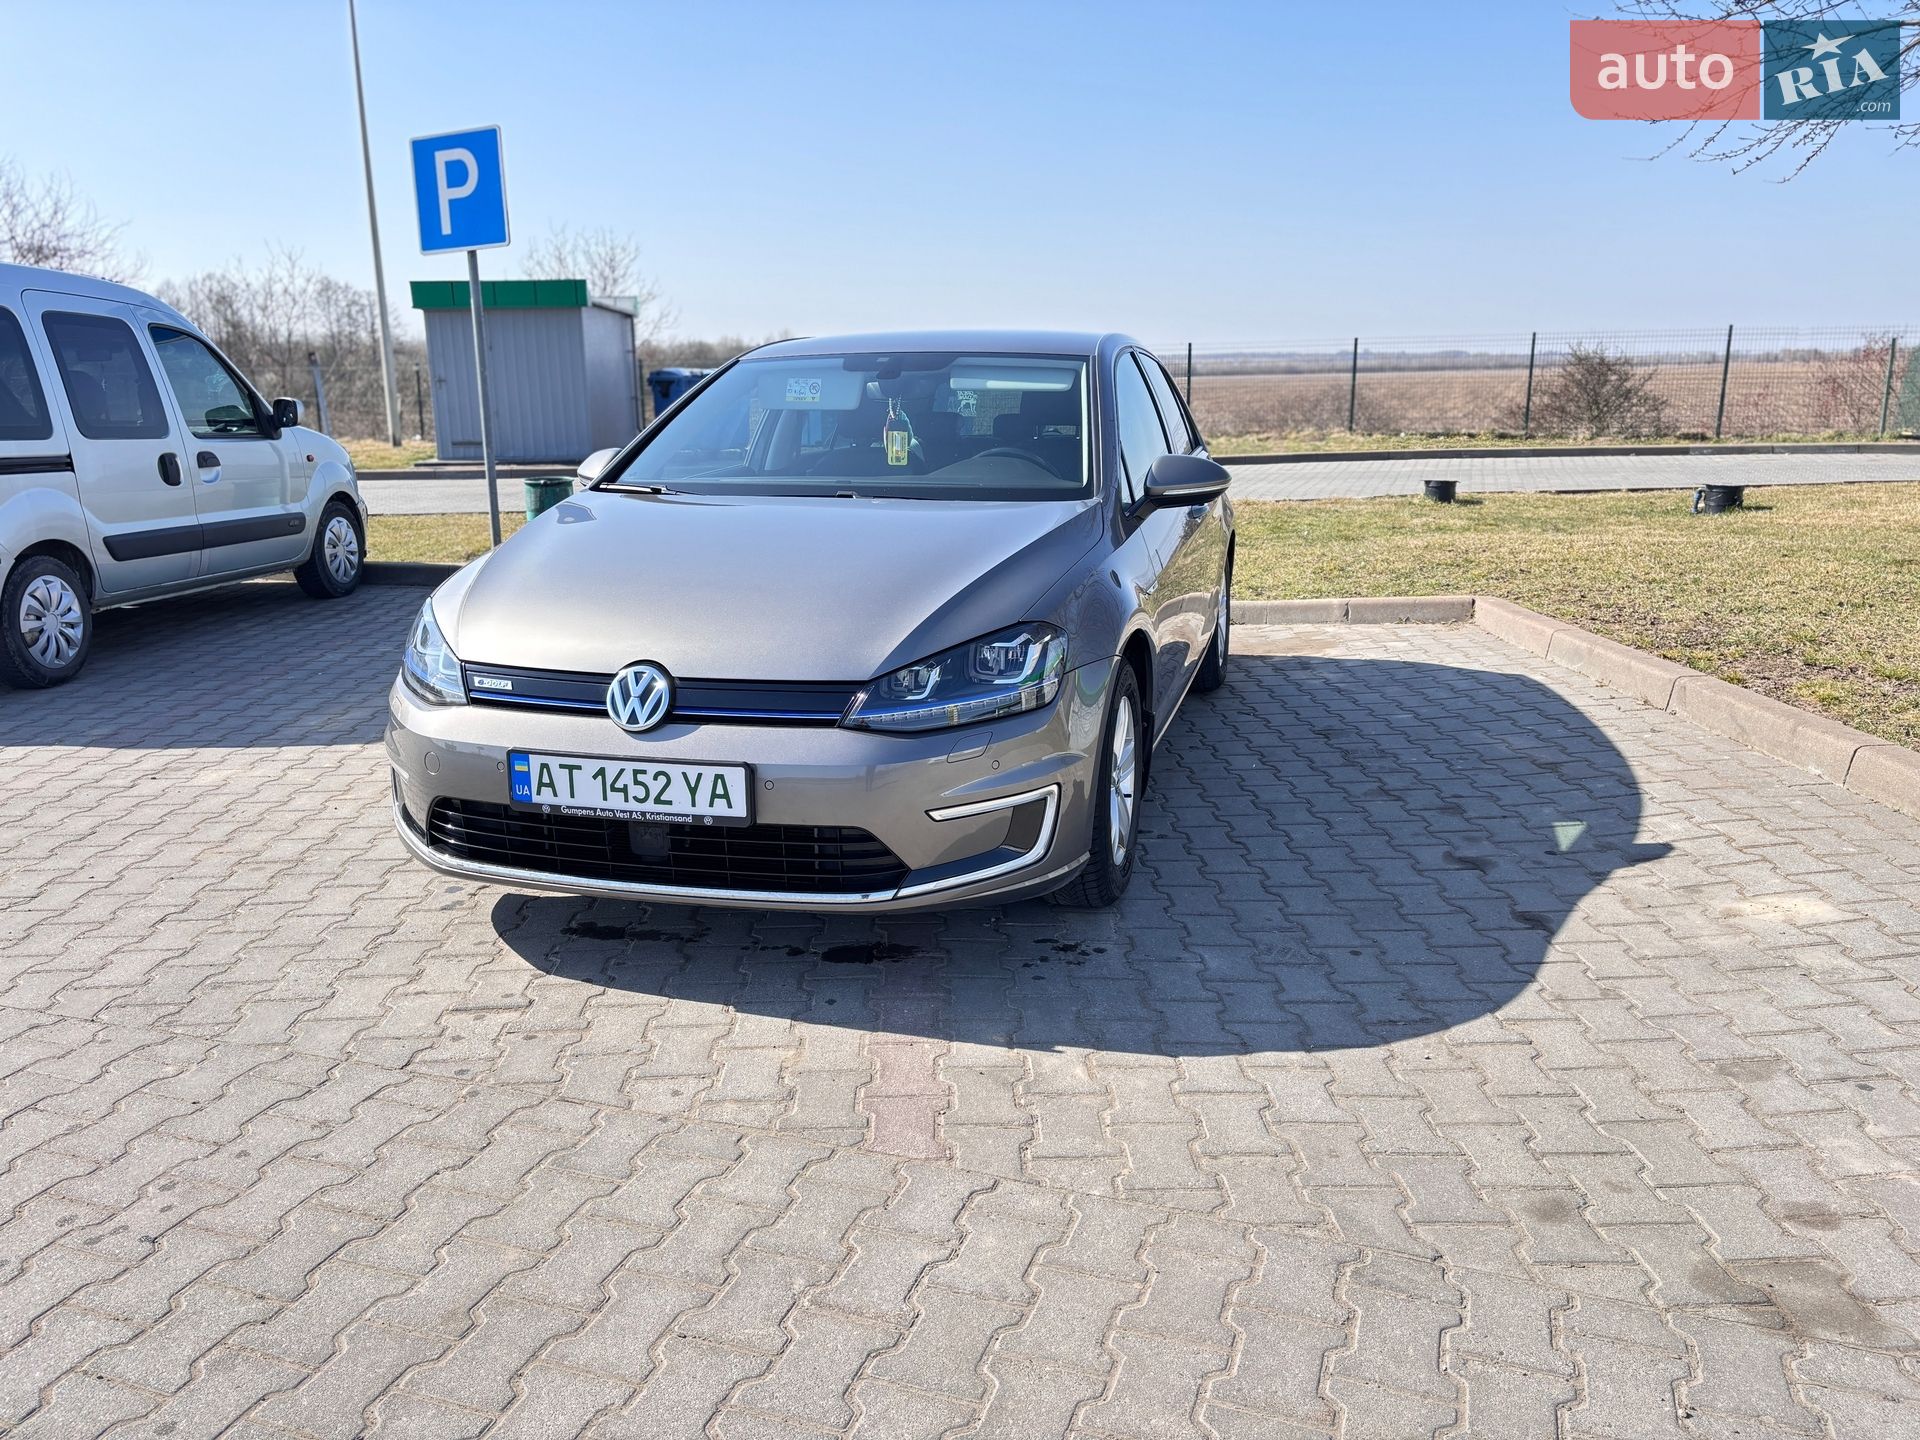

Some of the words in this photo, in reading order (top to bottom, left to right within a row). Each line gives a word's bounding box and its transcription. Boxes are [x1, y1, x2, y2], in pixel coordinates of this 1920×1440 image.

[434, 147, 479, 236] P
[515, 784, 530, 796] UA
[536, 762, 583, 799] AT
[591, 766, 673, 806] 1452
[681, 771, 733, 809] YA
[560, 805, 595, 816] Gumpens
[596, 808, 614, 818] Auto
[614, 810, 630, 819] Vest
[631, 811, 645, 821] AS,
[646, 812, 693, 823] Kristiansand
